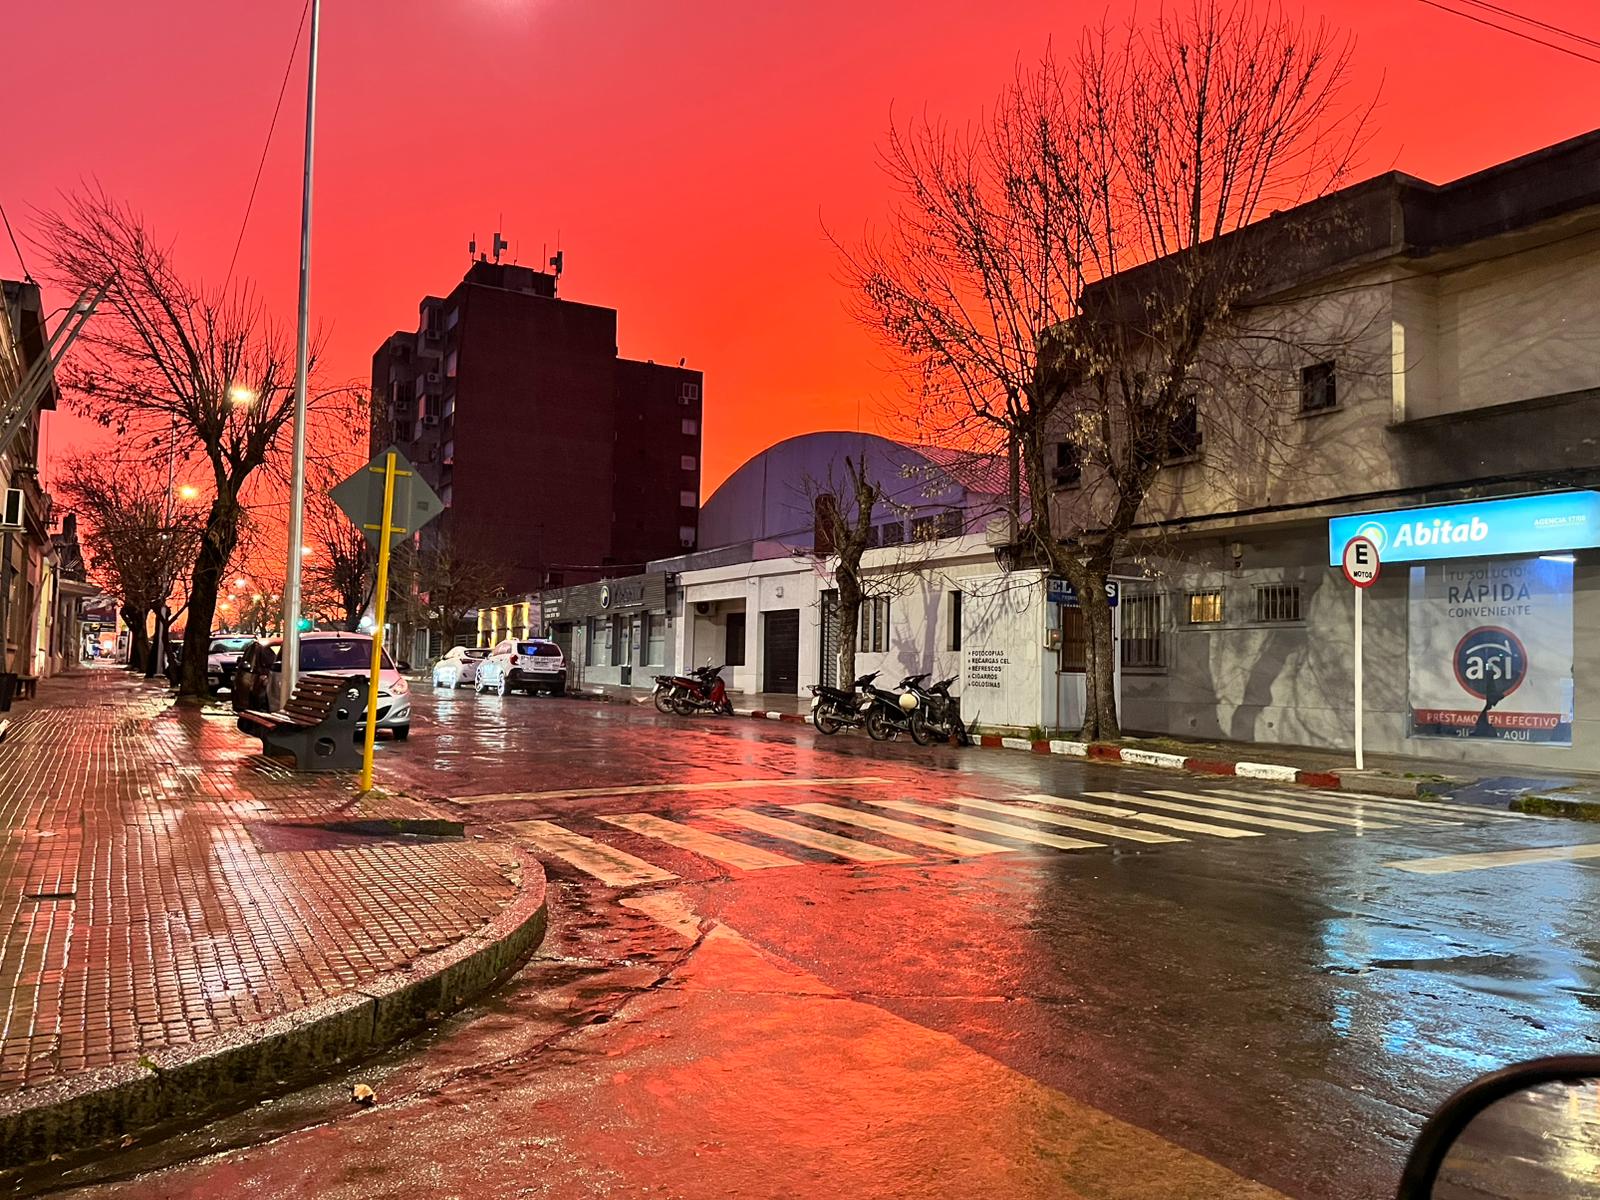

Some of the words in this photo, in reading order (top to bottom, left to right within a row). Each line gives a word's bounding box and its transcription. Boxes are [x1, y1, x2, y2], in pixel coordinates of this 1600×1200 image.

[1392, 516, 1489, 548] Abitab
[1355, 543, 1368, 564] E
[1353, 570, 1373, 579] MOTOS
[1449, 570, 1464, 581] TU
[1448, 580, 1531, 604] RÁPIDA
[1448, 605, 1532, 618] CONVENIENTE
[1487, 714, 1502, 726] EN
[1505, 714, 1558, 728] EFECTIVO
[1503, 727, 1530, 741] AQUÍ
